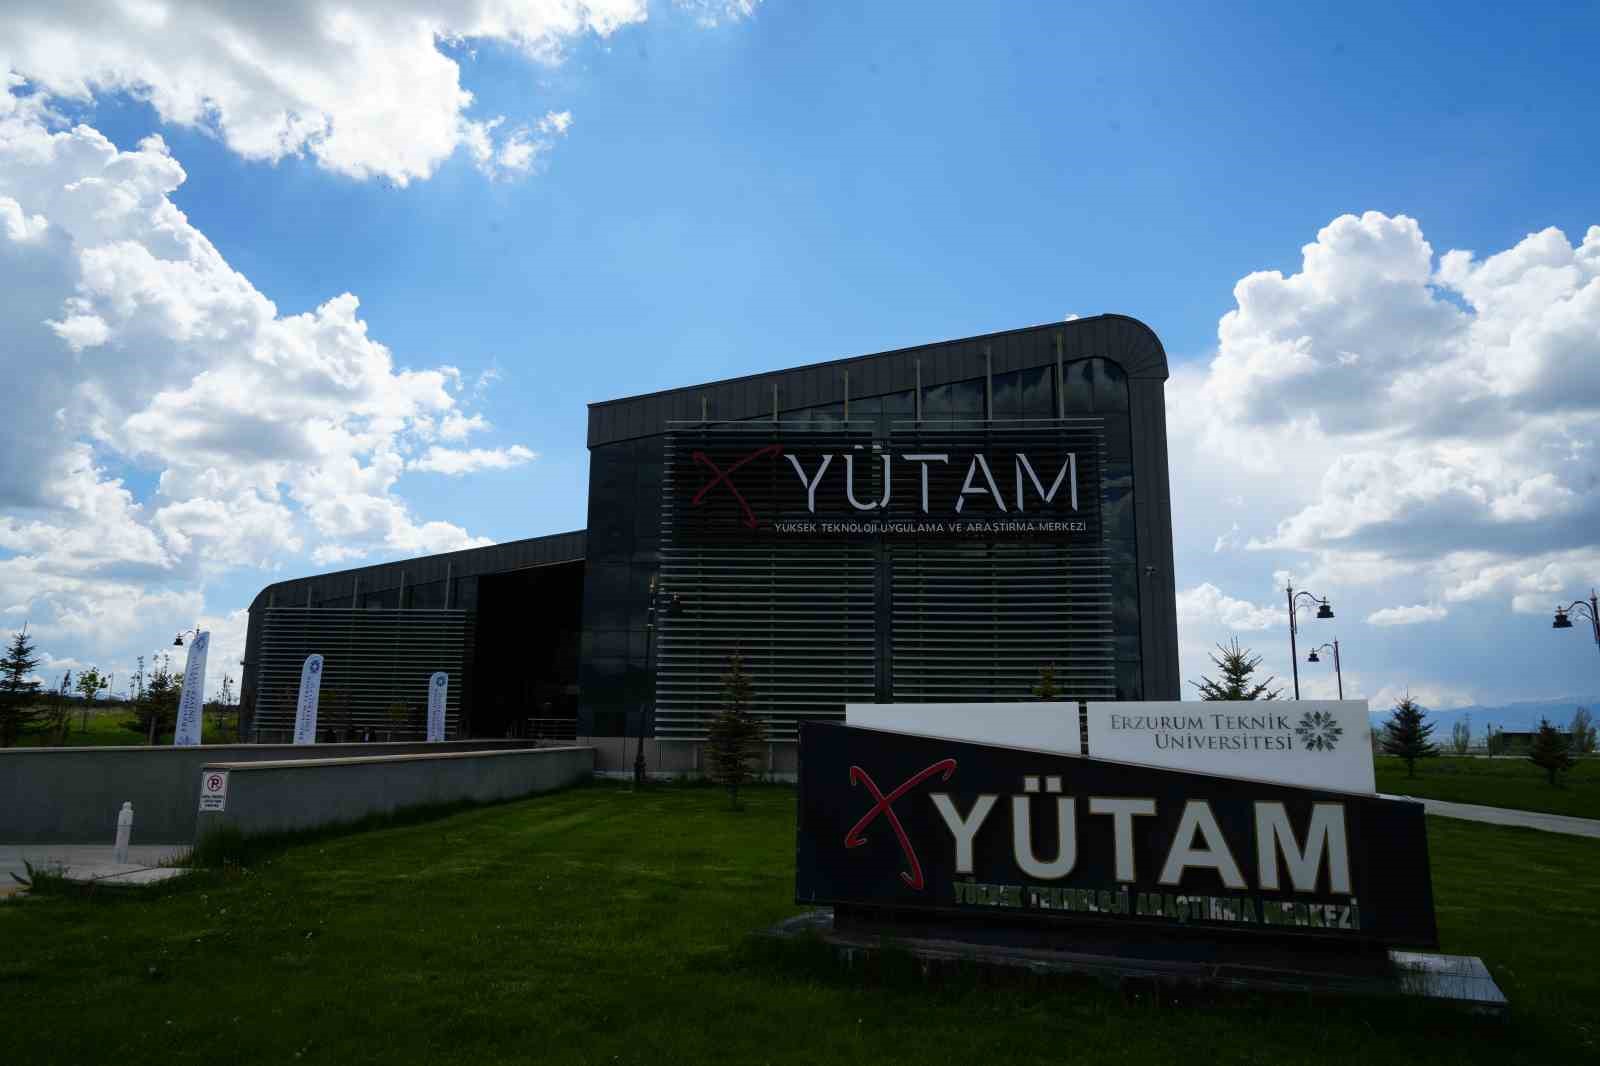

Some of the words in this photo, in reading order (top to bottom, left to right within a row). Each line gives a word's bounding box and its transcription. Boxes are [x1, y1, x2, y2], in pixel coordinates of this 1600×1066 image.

[784, 444, 1079, 514] YÜTAM
[880, 522, 945, 533] UYGULAMA
[948, 522, 961, 532] VE
[1039, 519, 1087, 532] MERKEZİ
[1110, 714, 1204, 730] ERZURUM
[1210, 712, 1292, 730] TEKNİK
[1155, 730, 1294, 750] ÜNİVERSİTESİ
[929, 776, 1352, 895] YÜTAM
